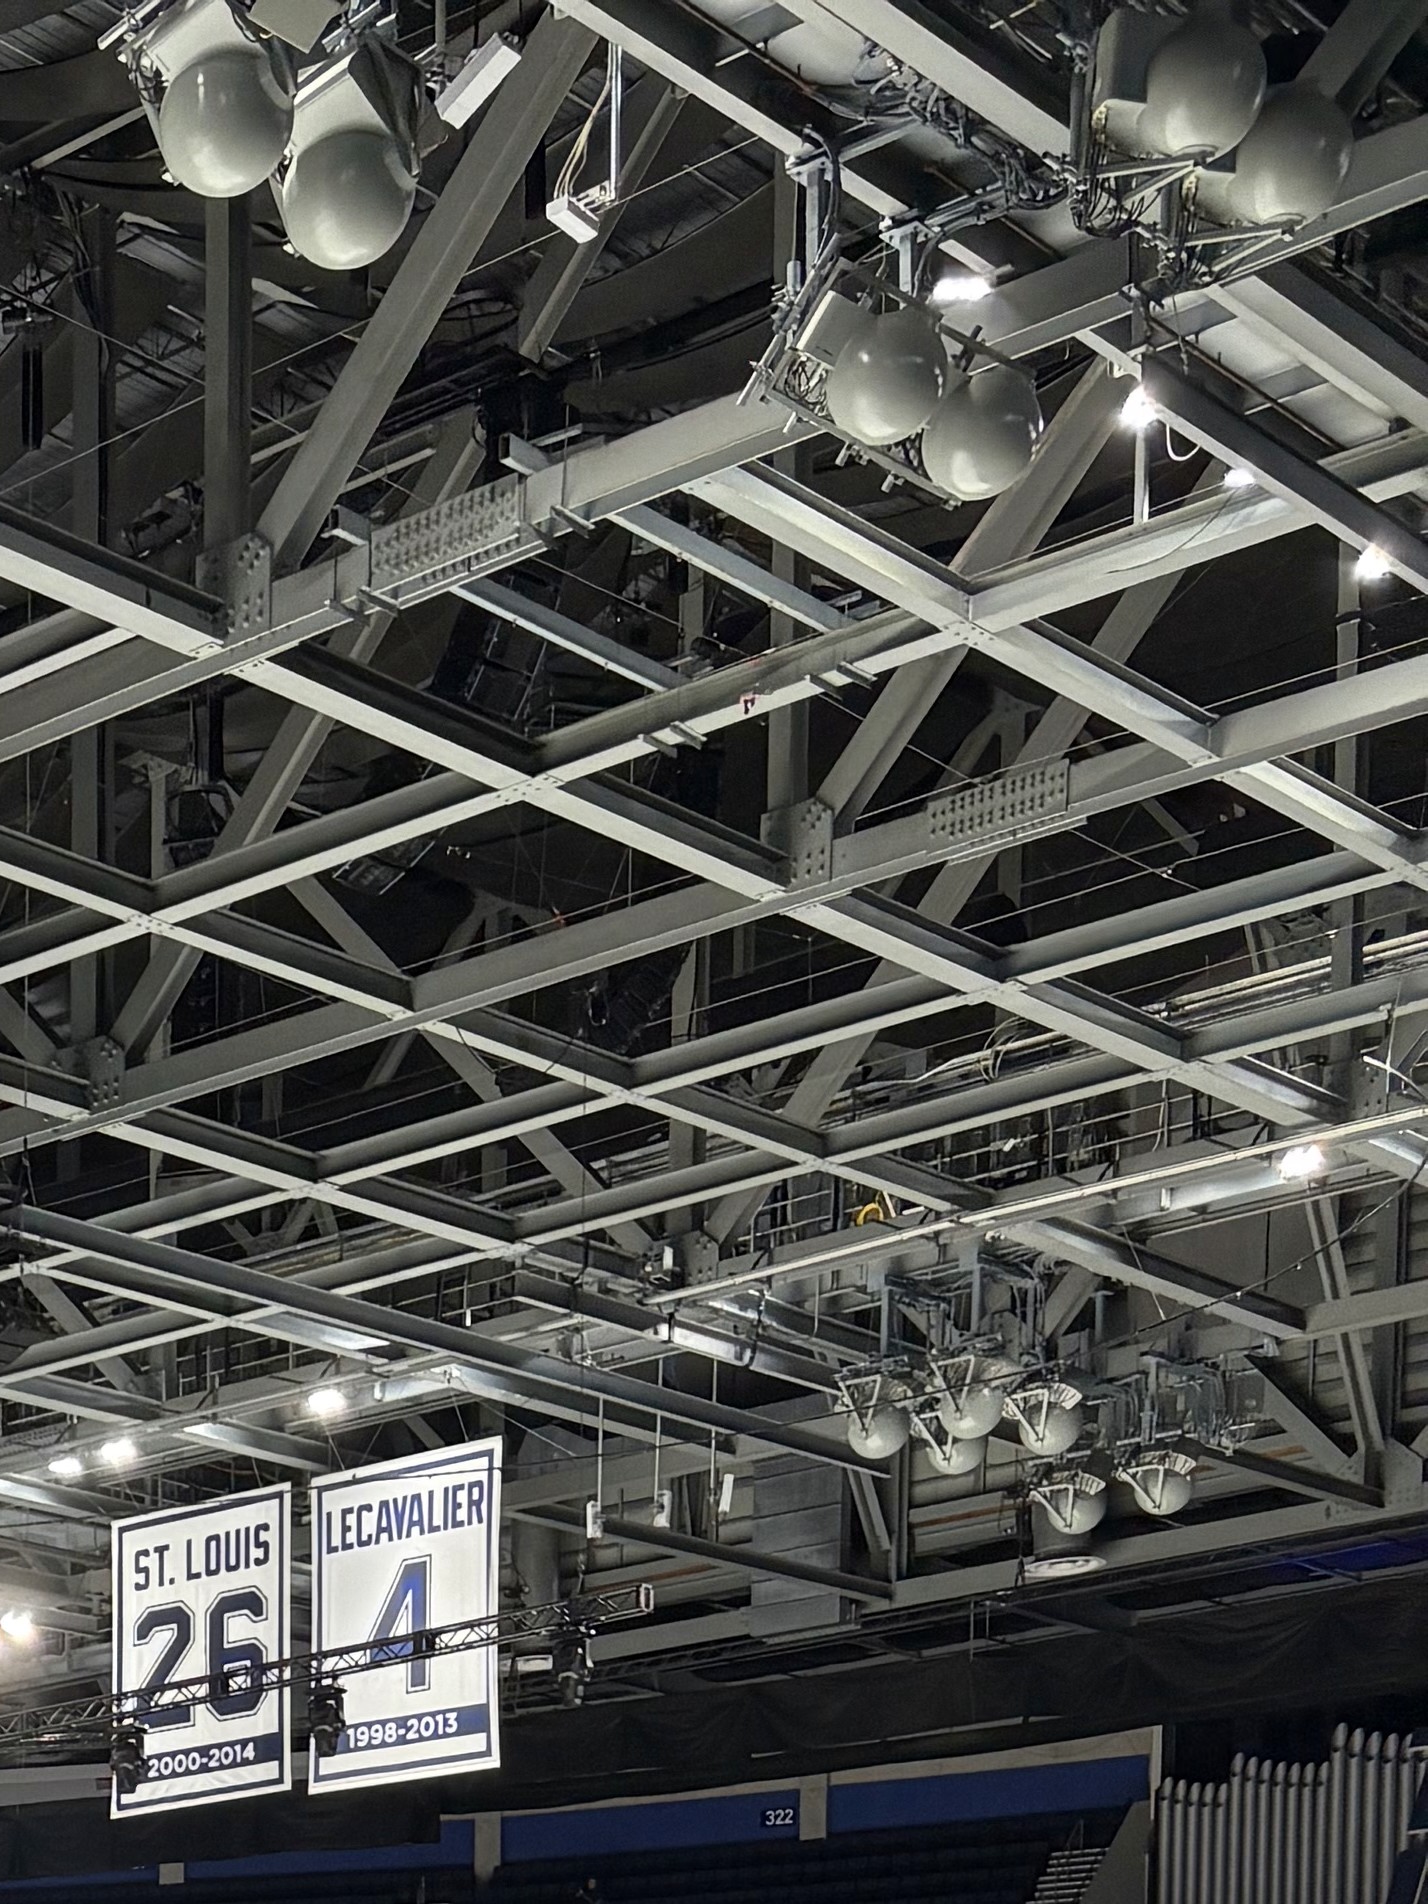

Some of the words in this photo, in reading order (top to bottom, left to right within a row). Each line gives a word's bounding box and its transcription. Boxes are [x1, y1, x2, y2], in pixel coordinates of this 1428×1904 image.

[325, 1479, 485, 1555] LECAVALIER
[133, 1545, 175, 1592] ST.
[186, 1522, 270, 1581] LOUIS
[365, 1553, 432, 1695] 4
[133, 1585, 270, 1734] 26
[147, 1740, 256, 1779] 2000-2014
[346, 1711, 458, 1749] 1998-2013
[765, 1808, 794, 1826] 322
